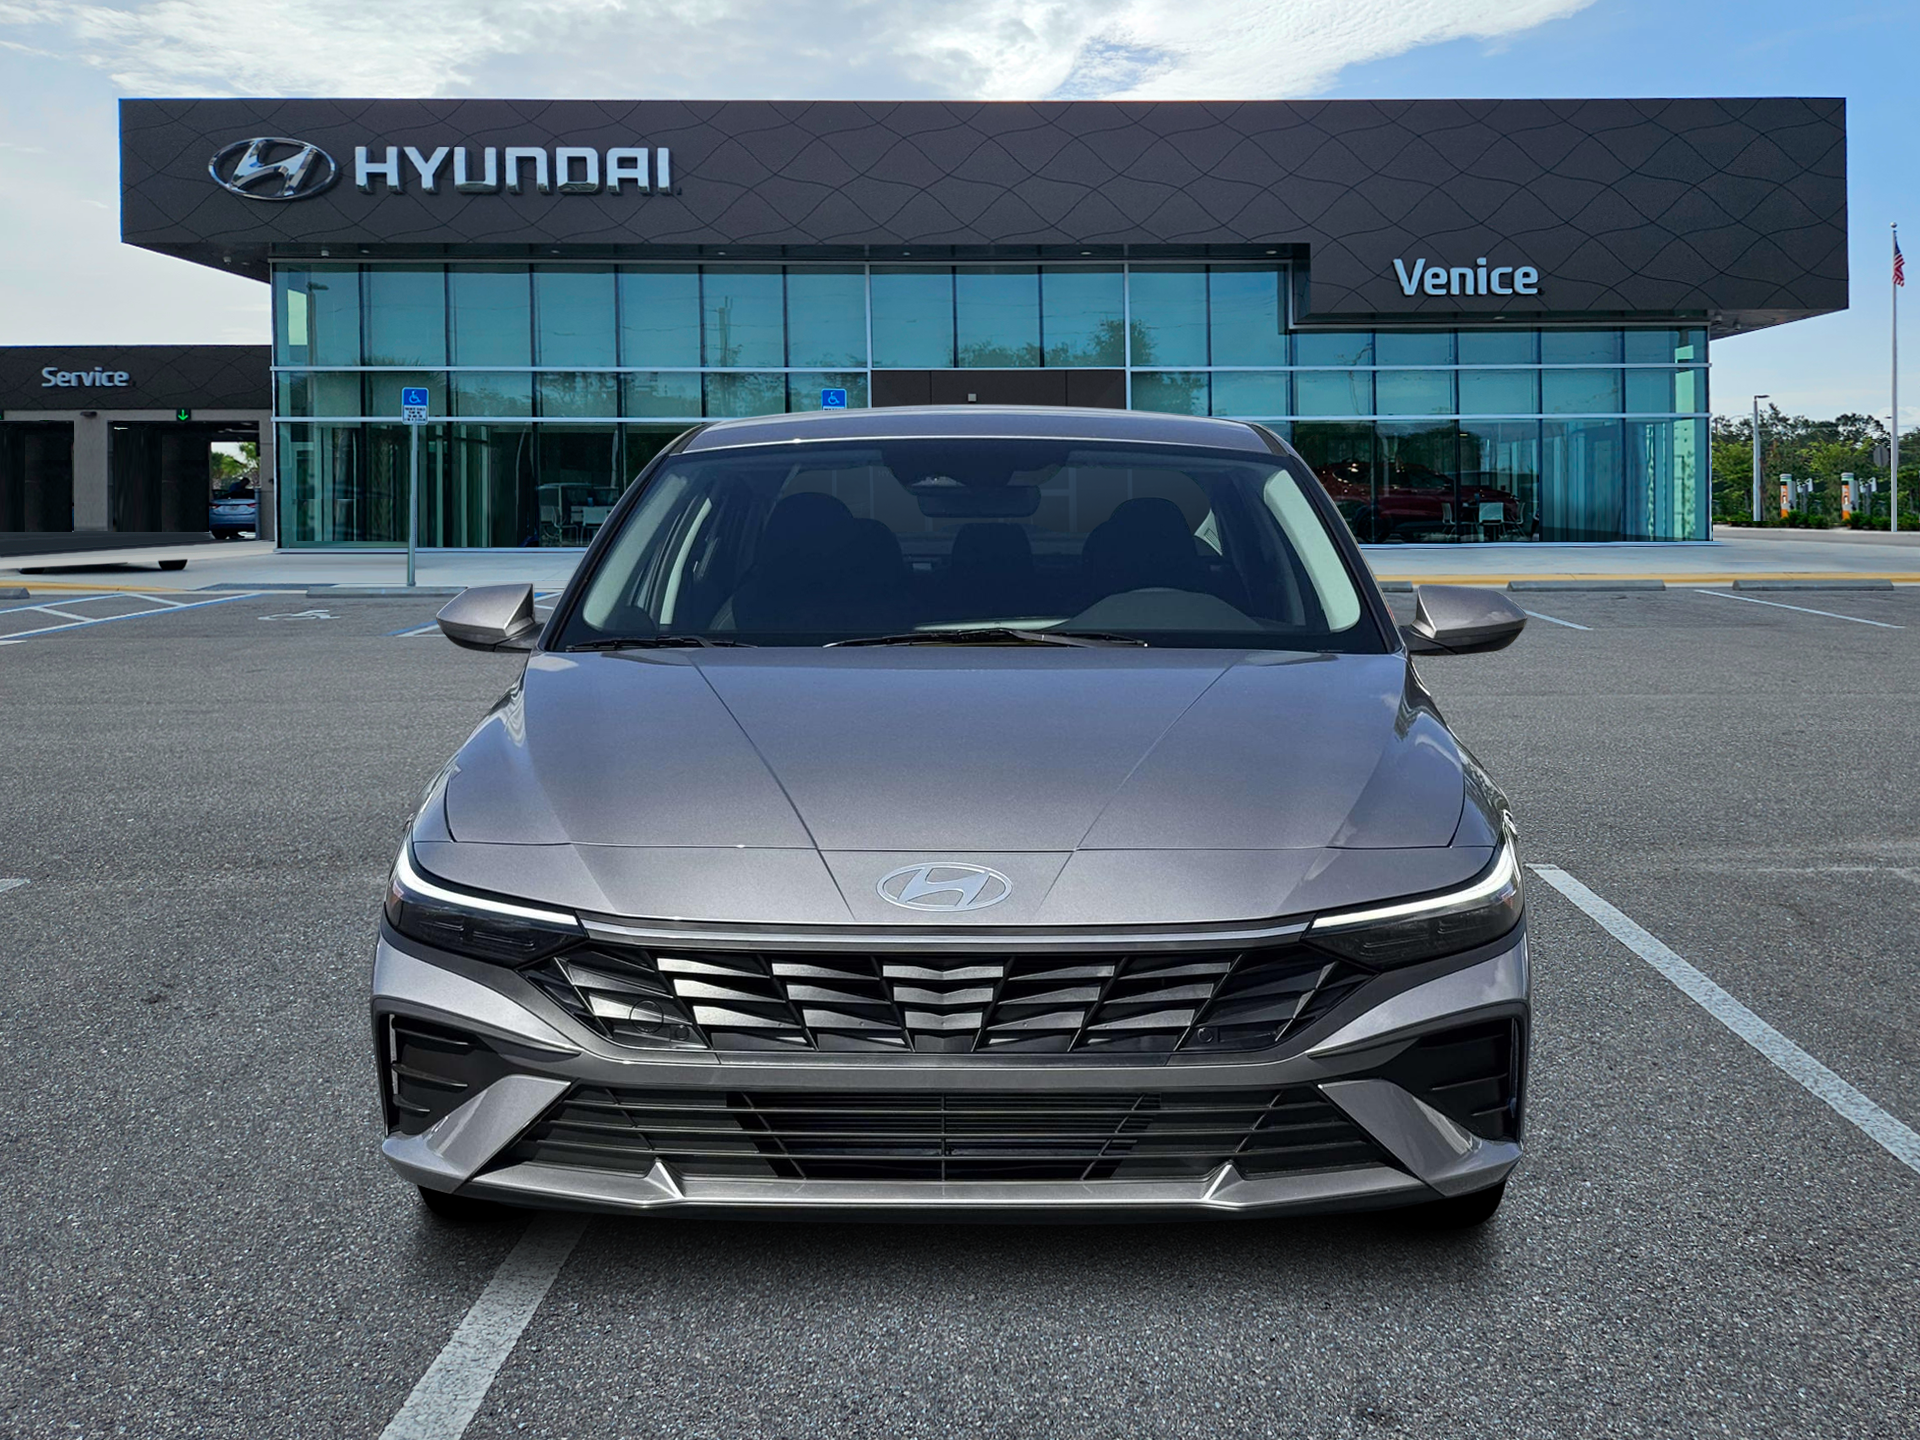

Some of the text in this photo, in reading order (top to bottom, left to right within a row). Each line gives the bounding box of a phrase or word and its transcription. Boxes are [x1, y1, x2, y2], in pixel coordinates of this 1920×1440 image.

[354, 146, 672, 194] HYUNDAI
[1393, 257, 1539, 296] Venice
[41, 366, 130, 387] Service
